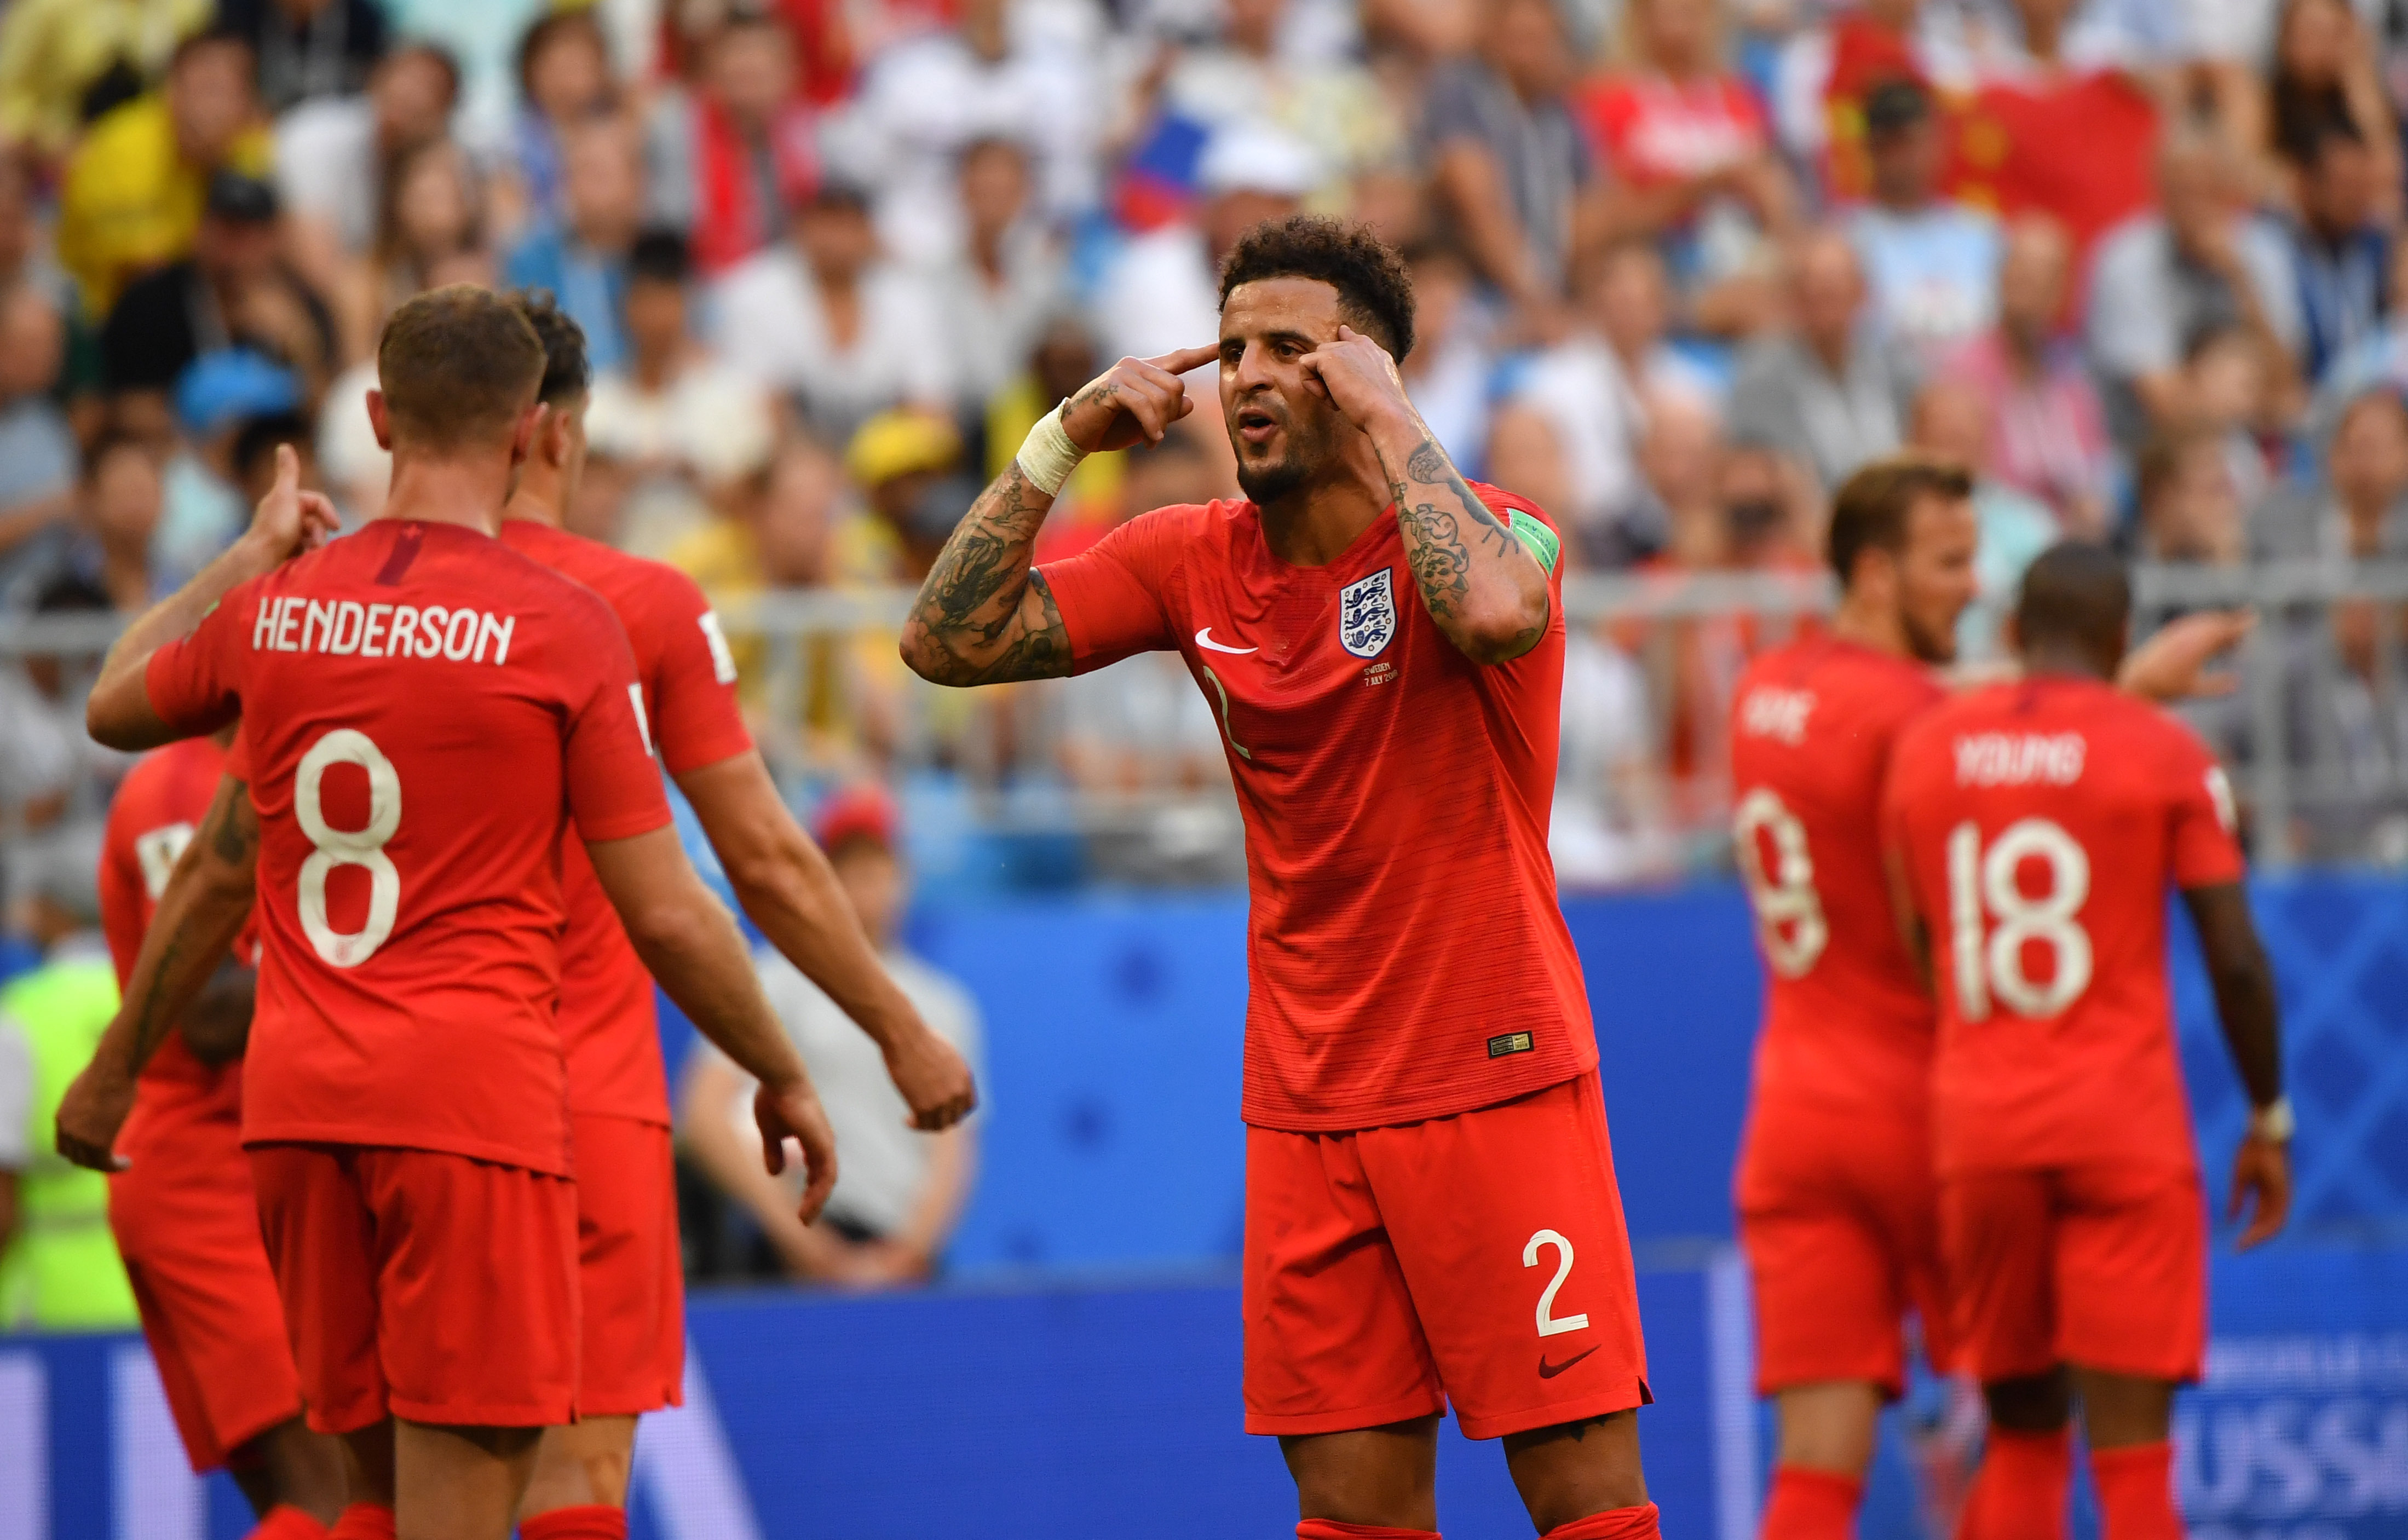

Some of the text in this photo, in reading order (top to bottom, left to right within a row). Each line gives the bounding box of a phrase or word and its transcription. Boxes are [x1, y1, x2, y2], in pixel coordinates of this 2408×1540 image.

[252, 596, 515, 666] HENDERSON
[1364, 662, 1391, 676] SWEDEN
[1364, 678, 1369, 687] 7
[1371, 674, 1383, 685] JULY
[1953, 730, 2087, 790] YOUNG
[294, 728, 402, 968] 8
[1945, 815, 2095, 1025] 18
[1523, 1228, 1589, 1337] 2
